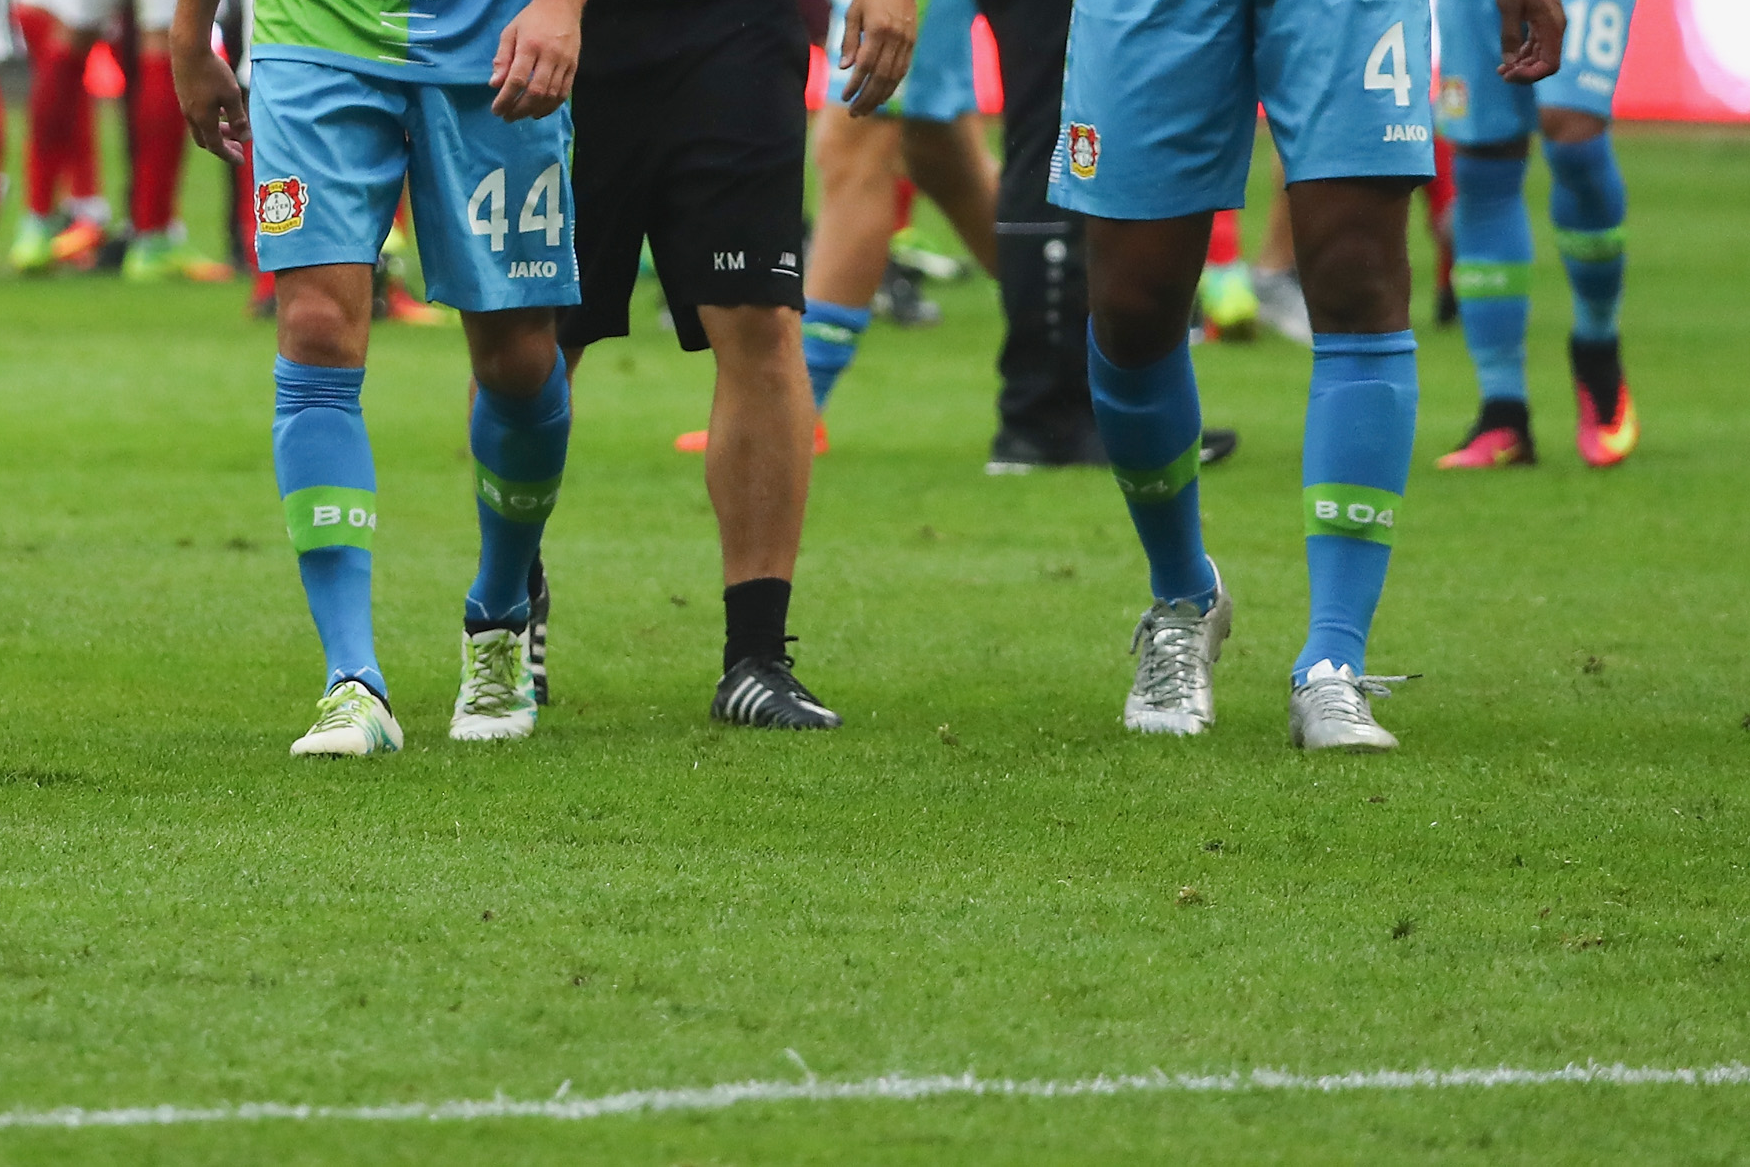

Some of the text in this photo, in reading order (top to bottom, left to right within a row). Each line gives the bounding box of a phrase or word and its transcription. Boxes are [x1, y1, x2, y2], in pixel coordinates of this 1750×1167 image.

[1363, 20, 1411, 106] 4
[1382, 124, 1429, 142] JAKO
[467, 161, 564, 252] 44
[508, 260, 558, 279] JAKO
[713, 250, 746, 271] KM
